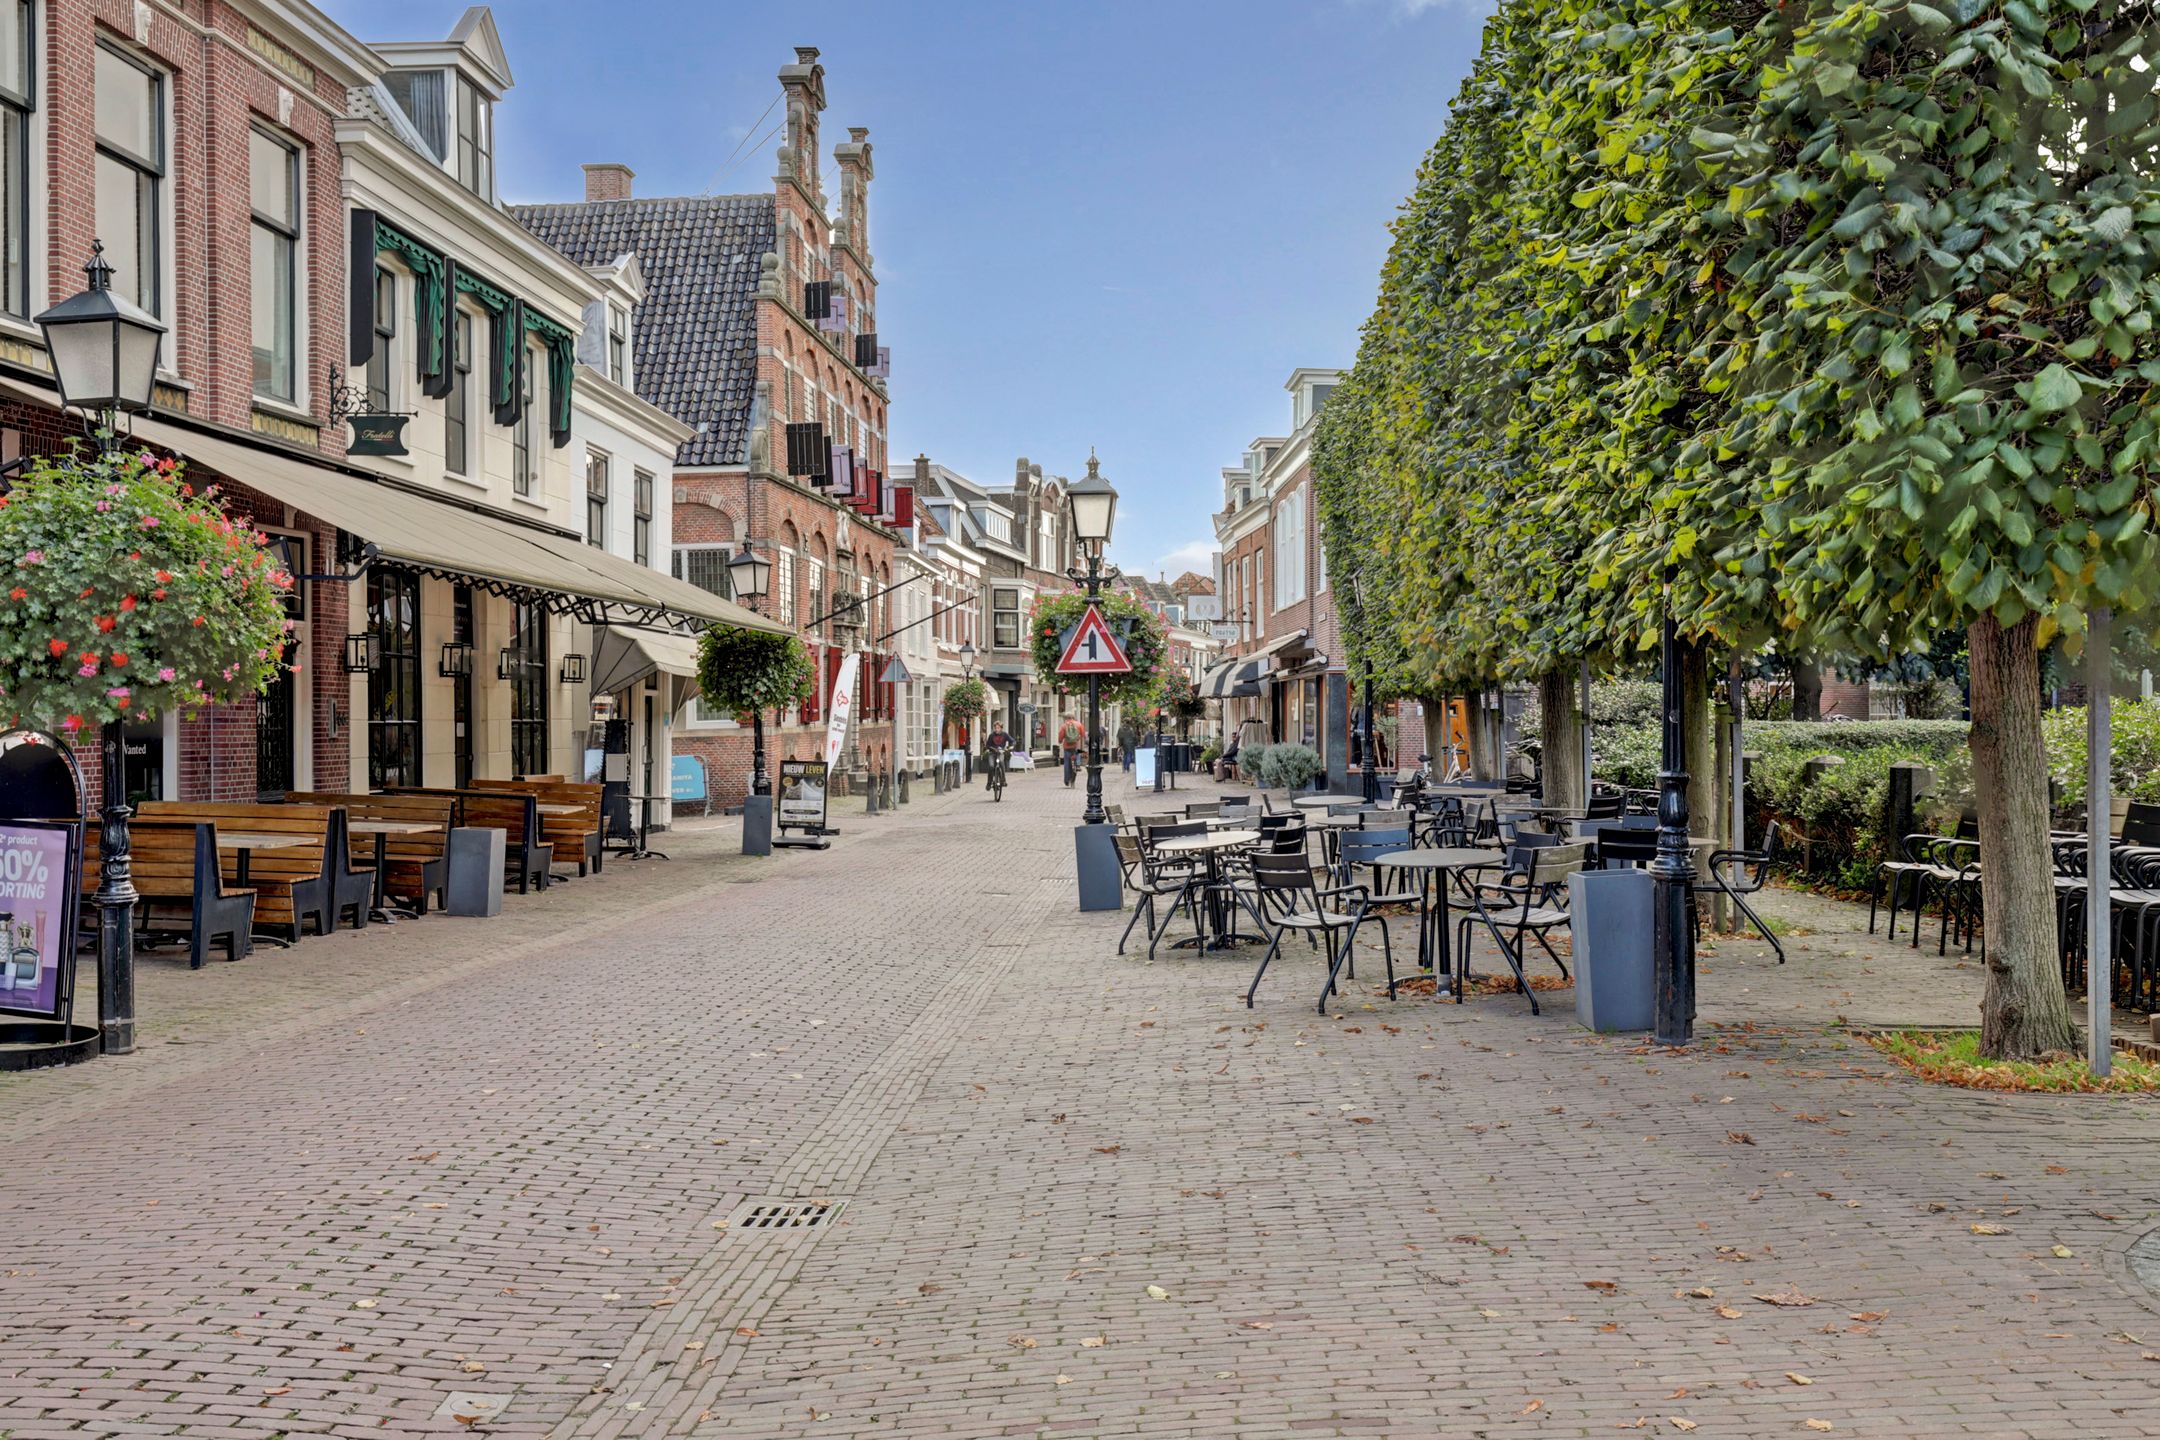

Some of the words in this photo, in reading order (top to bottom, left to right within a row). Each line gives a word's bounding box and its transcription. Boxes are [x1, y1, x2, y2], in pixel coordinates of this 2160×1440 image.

[362, 429, 395, 440] Fratelli
[783, 765, 804, 774] NIEUW
[805, 765, 825, 775] LEVEN
[7, 835, 38, 846] product
[0, 849, 48, 883] 0%
